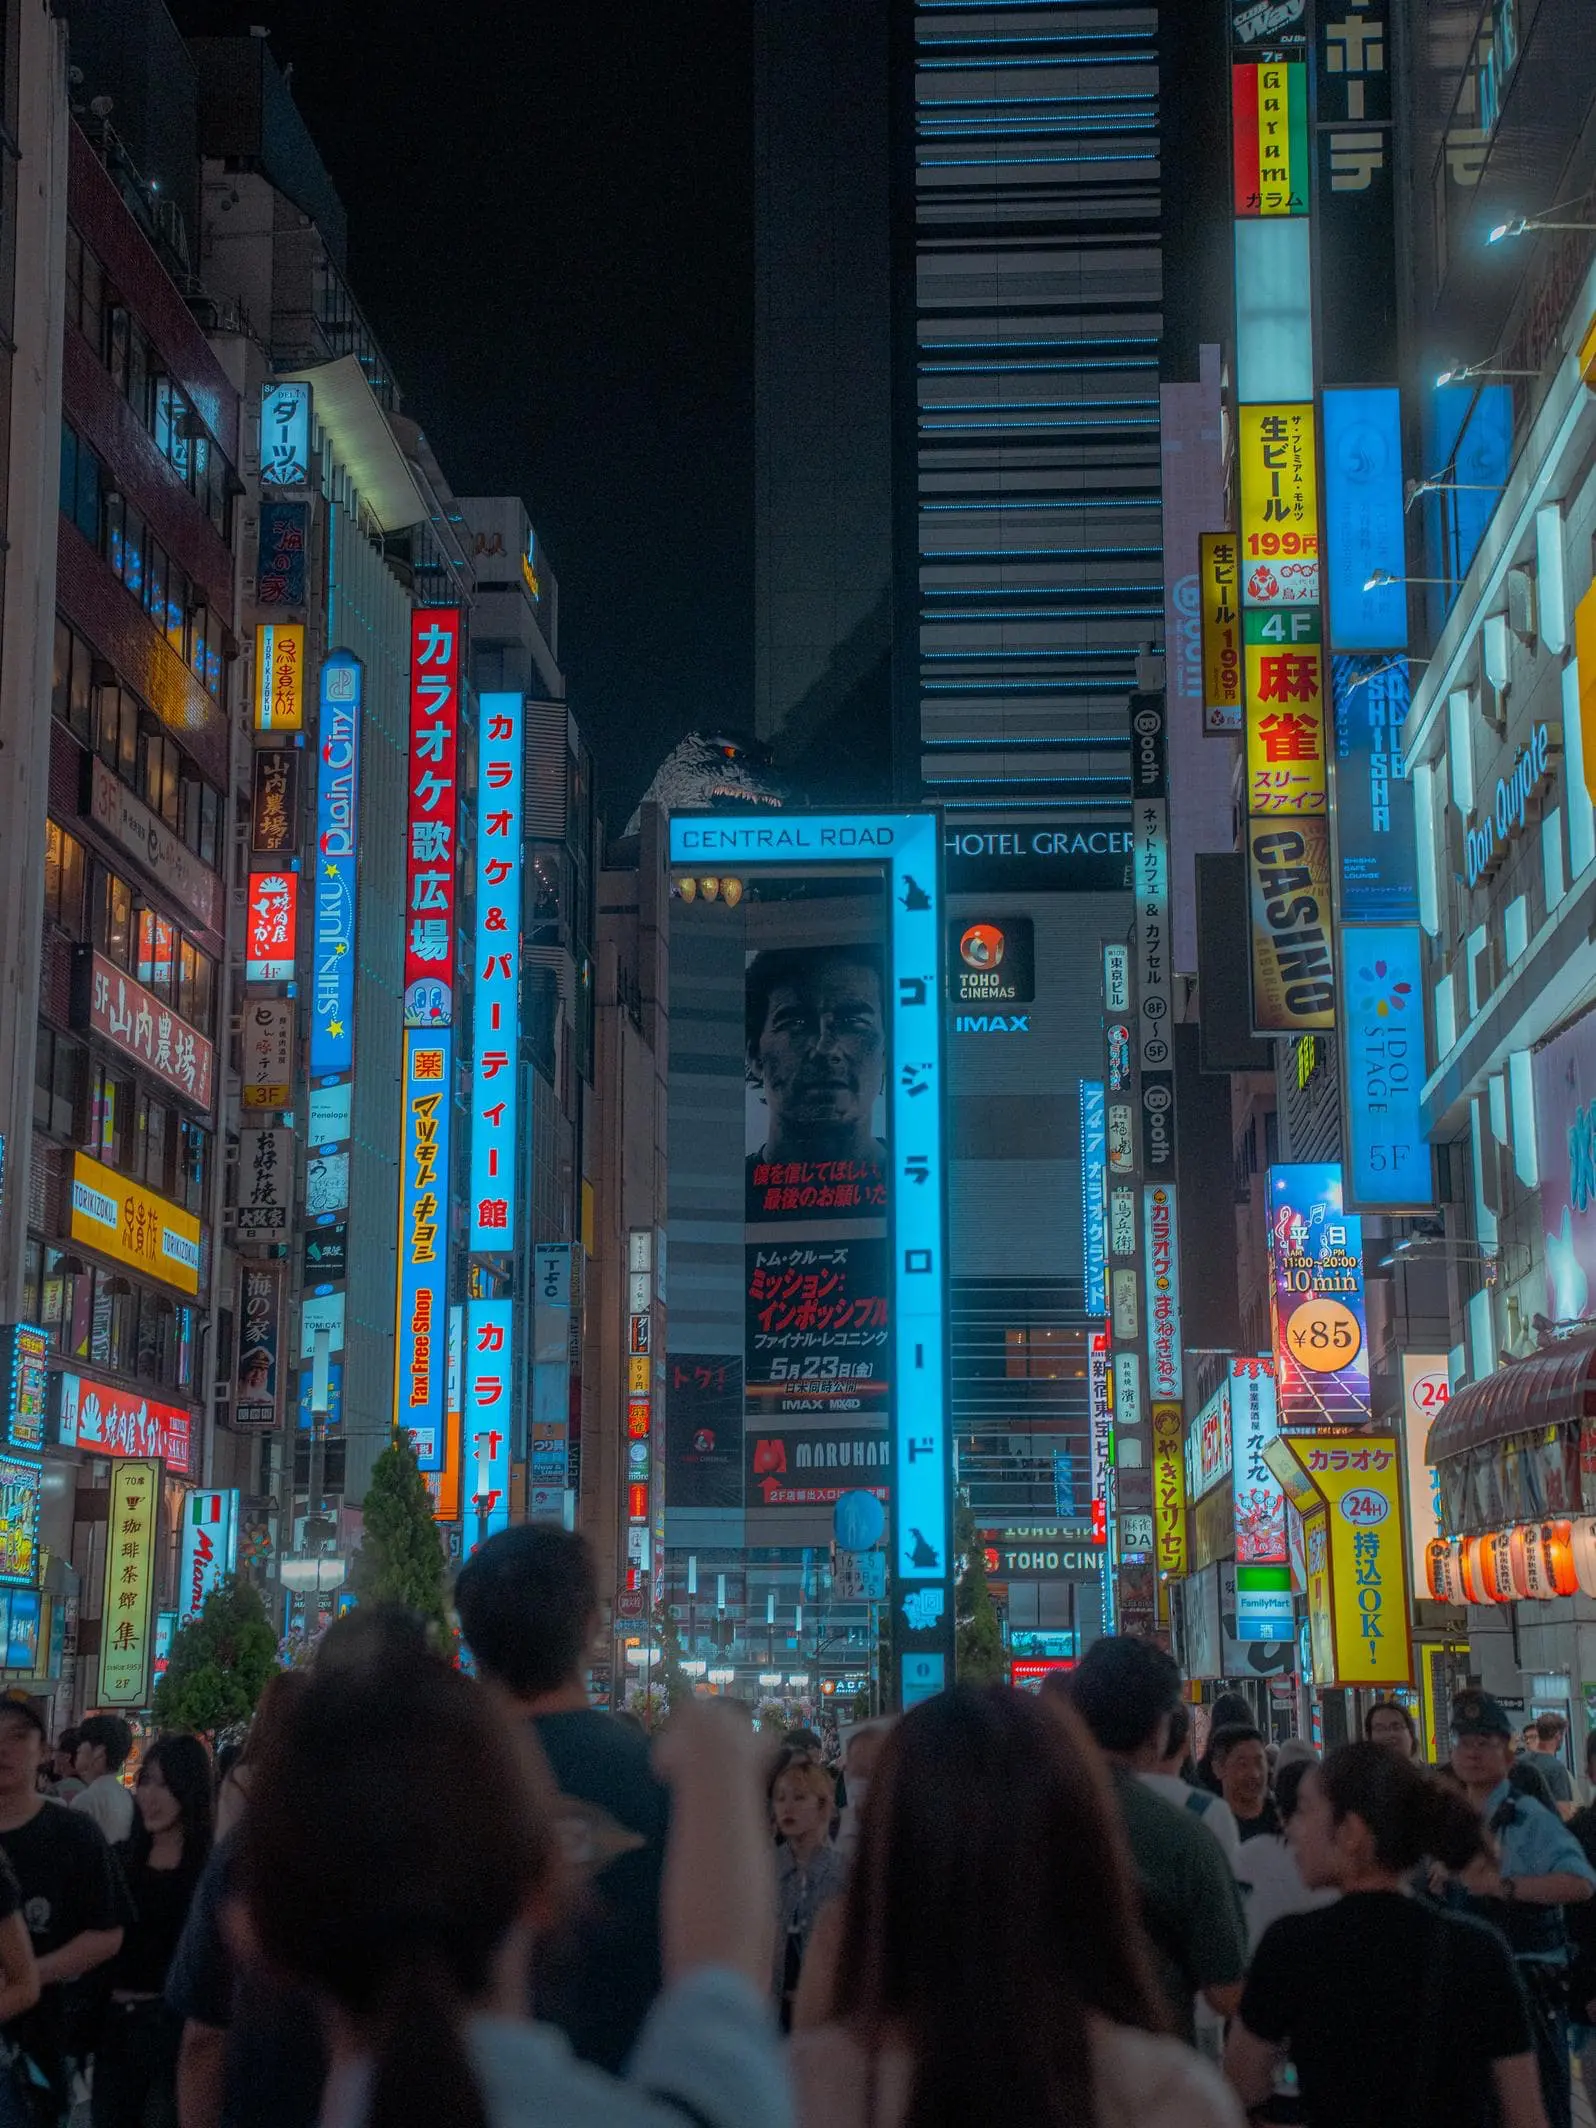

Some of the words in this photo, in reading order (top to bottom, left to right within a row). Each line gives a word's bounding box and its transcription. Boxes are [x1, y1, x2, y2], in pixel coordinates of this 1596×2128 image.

[1327, 0, 1384, 191] ホーテ
[1262, 71, 1288, 182] Garam
[1246, 192, 1304, 209] ガラム
[272, 400, 297, 467] ダーツ
[1260, 415, 1291, 523] 生ビール
[1291, 415, 1304, 521] ザ・プレミアム・モルツ
[1248, 532, 1319, 556] 199円
[1213, 544, 1236, 624] 生ビール
[1261, 613, 1311, 641] 4F
[276, 638, 296, 716] 鳥貴族
[1258, 652, 1321, 764] 麻雀
[1133, 709, 1161, 785] Booth
[259, 754, 289, 837] 山内農場
[411, 623, 452, 961] カラオケ歌広場
[1254, 772, 1312, 789] スリー
[1469, 814, 1494, 890] Don
[1497, 722, 1549, 842] Quijote
[683, 829, 811, 849] CENTRAL
[820, 827, 894, 847] ROAD
[944, 833, 1026, 857] HOTEL
[252, 900, 272, 957] さかい
[1253, 831, 1334, 1016] CASINO
[317, 882, 350, 1015] SHINJUKU
[260, 964, 281, 978] 4F
[960, 973, 1000, 986] TOHO
[1110, 957, 1124, 1006] 東京ビル
[960, 987, 1016, 999] CINEMAS
[110, 978, 197, 1093] 山内農場
[956, 1016, 1030, 1033] IMAX
[415, 1053, 442, 1076] 薬
[1364, 1026, 1388, 1115] STAGE
[1387, 1027, 1410, 1099] IDOL
[256, 1087, 280, 1103] 3F
[312, 1110, 348, 1120] Penelope
[314, 1135, 325, 1143] 7F
[1144, 1085, 1171, 1164] Booth
[250, 1132, 276, 1204] お好み焼
[412, 1092, 444, 1264] マツモトキヨシ
[1370, 1145, 1412, 1171] 5F
[899, 974, 935, 1465] ゴジラロード
[1289, 1225, 1346, 1245] 平日
[755, 1249, 848, 1268] トム・クルーズ
[1151, 1204, 1172, 1277] カラオケ
[1290, 1248, 1303, 1256] AM
[247, 1272, 272, 1341] 海の家
[305, 1321, 325, 1330] TOM
[325, 1320, 342, 1329] CAT
[412, 1289, 432, 1335] Shop
[1154, 1296, 1179, 1397] まねきねこ
[1292, 1320, 1352, 1348] ¥85
[411, 1336, 430, 1376] Free
[411, 1377, 430, 1407] Tax
[782, 1399, 823, 1411] IMAX
[1421, 1382, 1450, 1406] 24
[796, 1441, 890, 1468] MARUHAN
[1246, 1433, 1269, 1483] 九十九
[1308, 1449, 1394, 1472] カラオケ
[1157, 1438, 1182, 1578] やきとりセン
[1349, 1496, 1382, 1516] 24H
[1004, 1552, 1059, 1569] TOHO
[1240, 1597, 1290, 1609] FamilyMart
[115, 1678, 130, 1689] 2F
